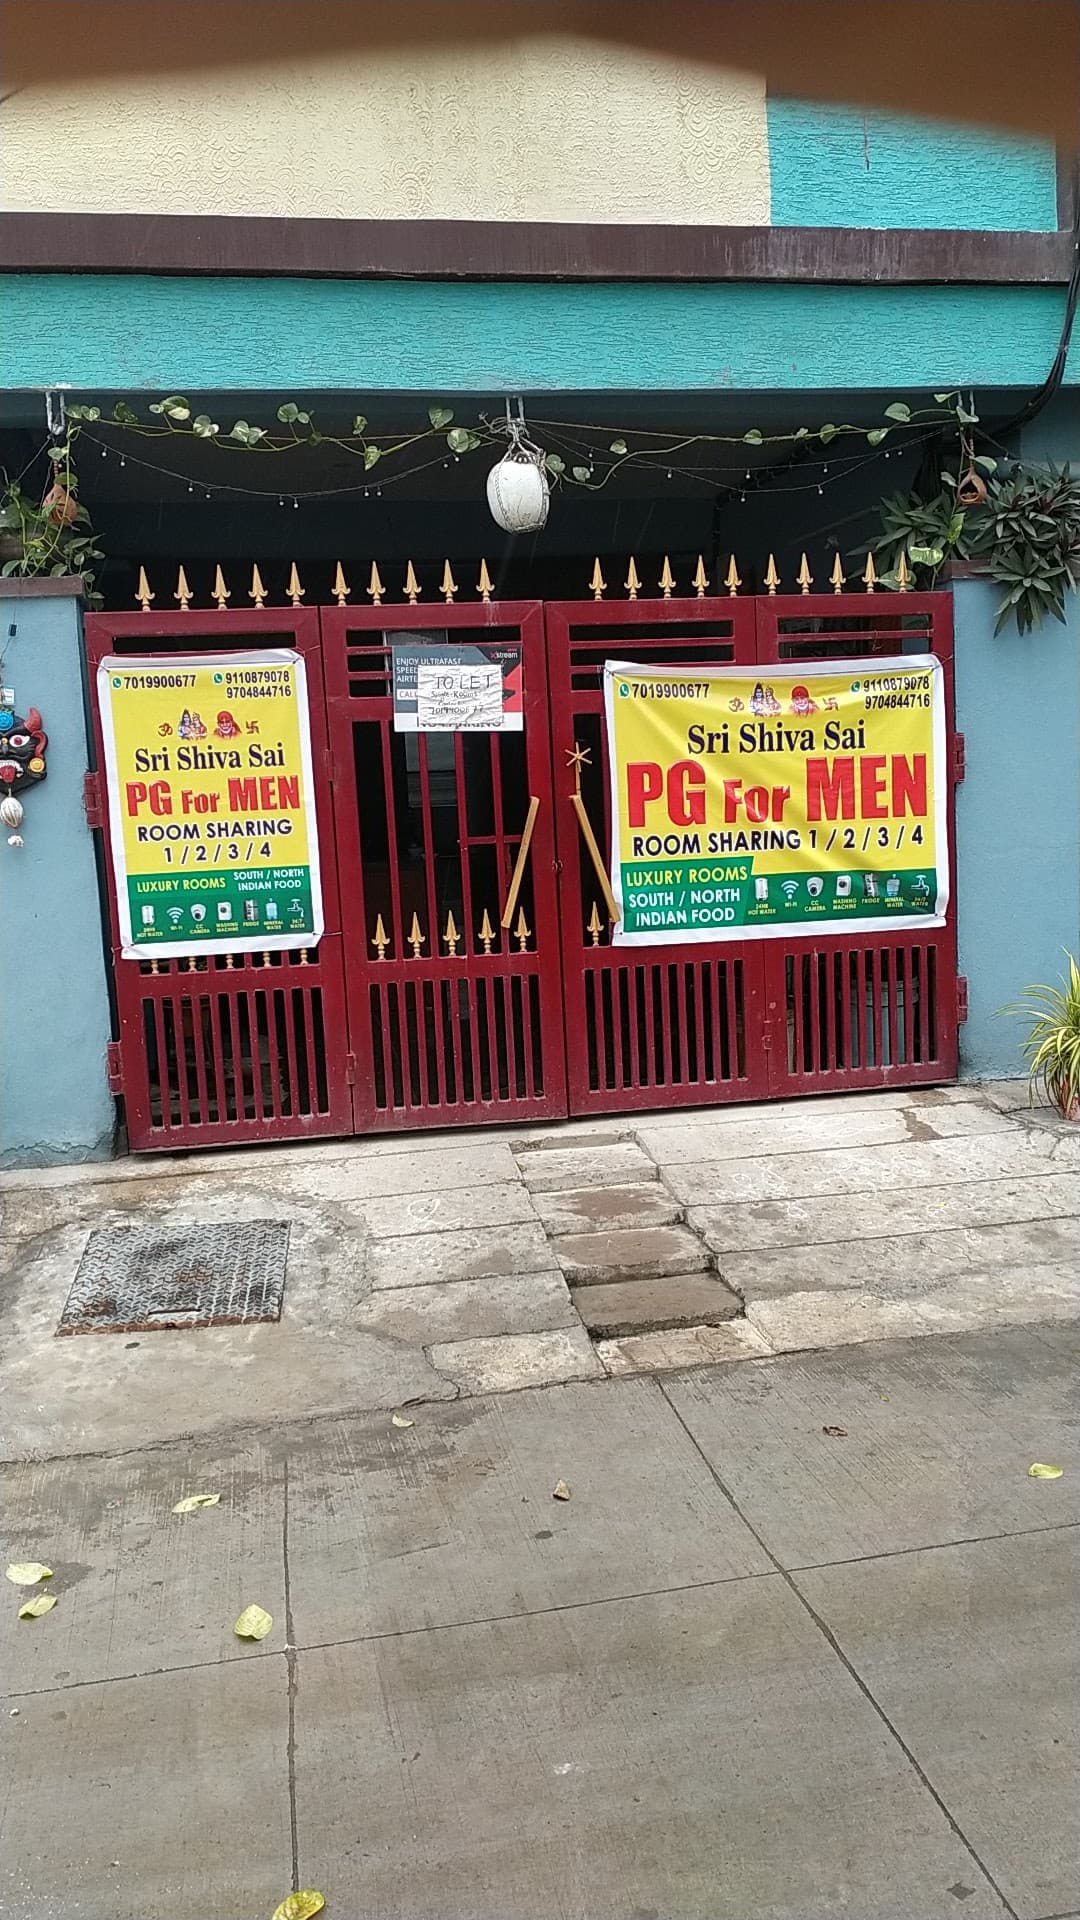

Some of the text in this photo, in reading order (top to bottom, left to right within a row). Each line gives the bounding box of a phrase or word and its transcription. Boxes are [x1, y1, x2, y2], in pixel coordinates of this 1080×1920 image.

[396, 658, 418, 666] ENJOY
[124, 674, 197, 690] 7019900677
[225, 670, 290, 684] 9110879078
[435, 675, 491, 690] TO LET
[862, 676, 930, 693] 9110879078
[226, 686, 292, 698] 9704844716
[632, 683, 710, 699] 7019900677
[864, 692, 930, 710] 9704844716
[687, 719, 866, 754] Sri Shiva Sai
[135, 742, 285, 772] Sri Shiva Sai
[125, 774, 300, 817] PG For MEN
[626, 753, 928, 828] PG For MEN
[138, 819, 292, 842] ROOM SHARING
[632, 825, 924, 857] ROOM SHARING 1 / 2 / 3 / 4
[164, 842, 271, 864] 1 / 2 / 3 / 4
[234, 868, 304, 880] SOUTH / NORTH
[626, 866, 748, 887] LUXURY ROOMS
[136, 877, 226, 893] LUXURY ROOMS
[238, 880, 302, 892] INDIAN FOOD
[629, 888, 740, 908] SOUTH / NORTH
[636, 908, 735, 927] INDIAN FOOD
